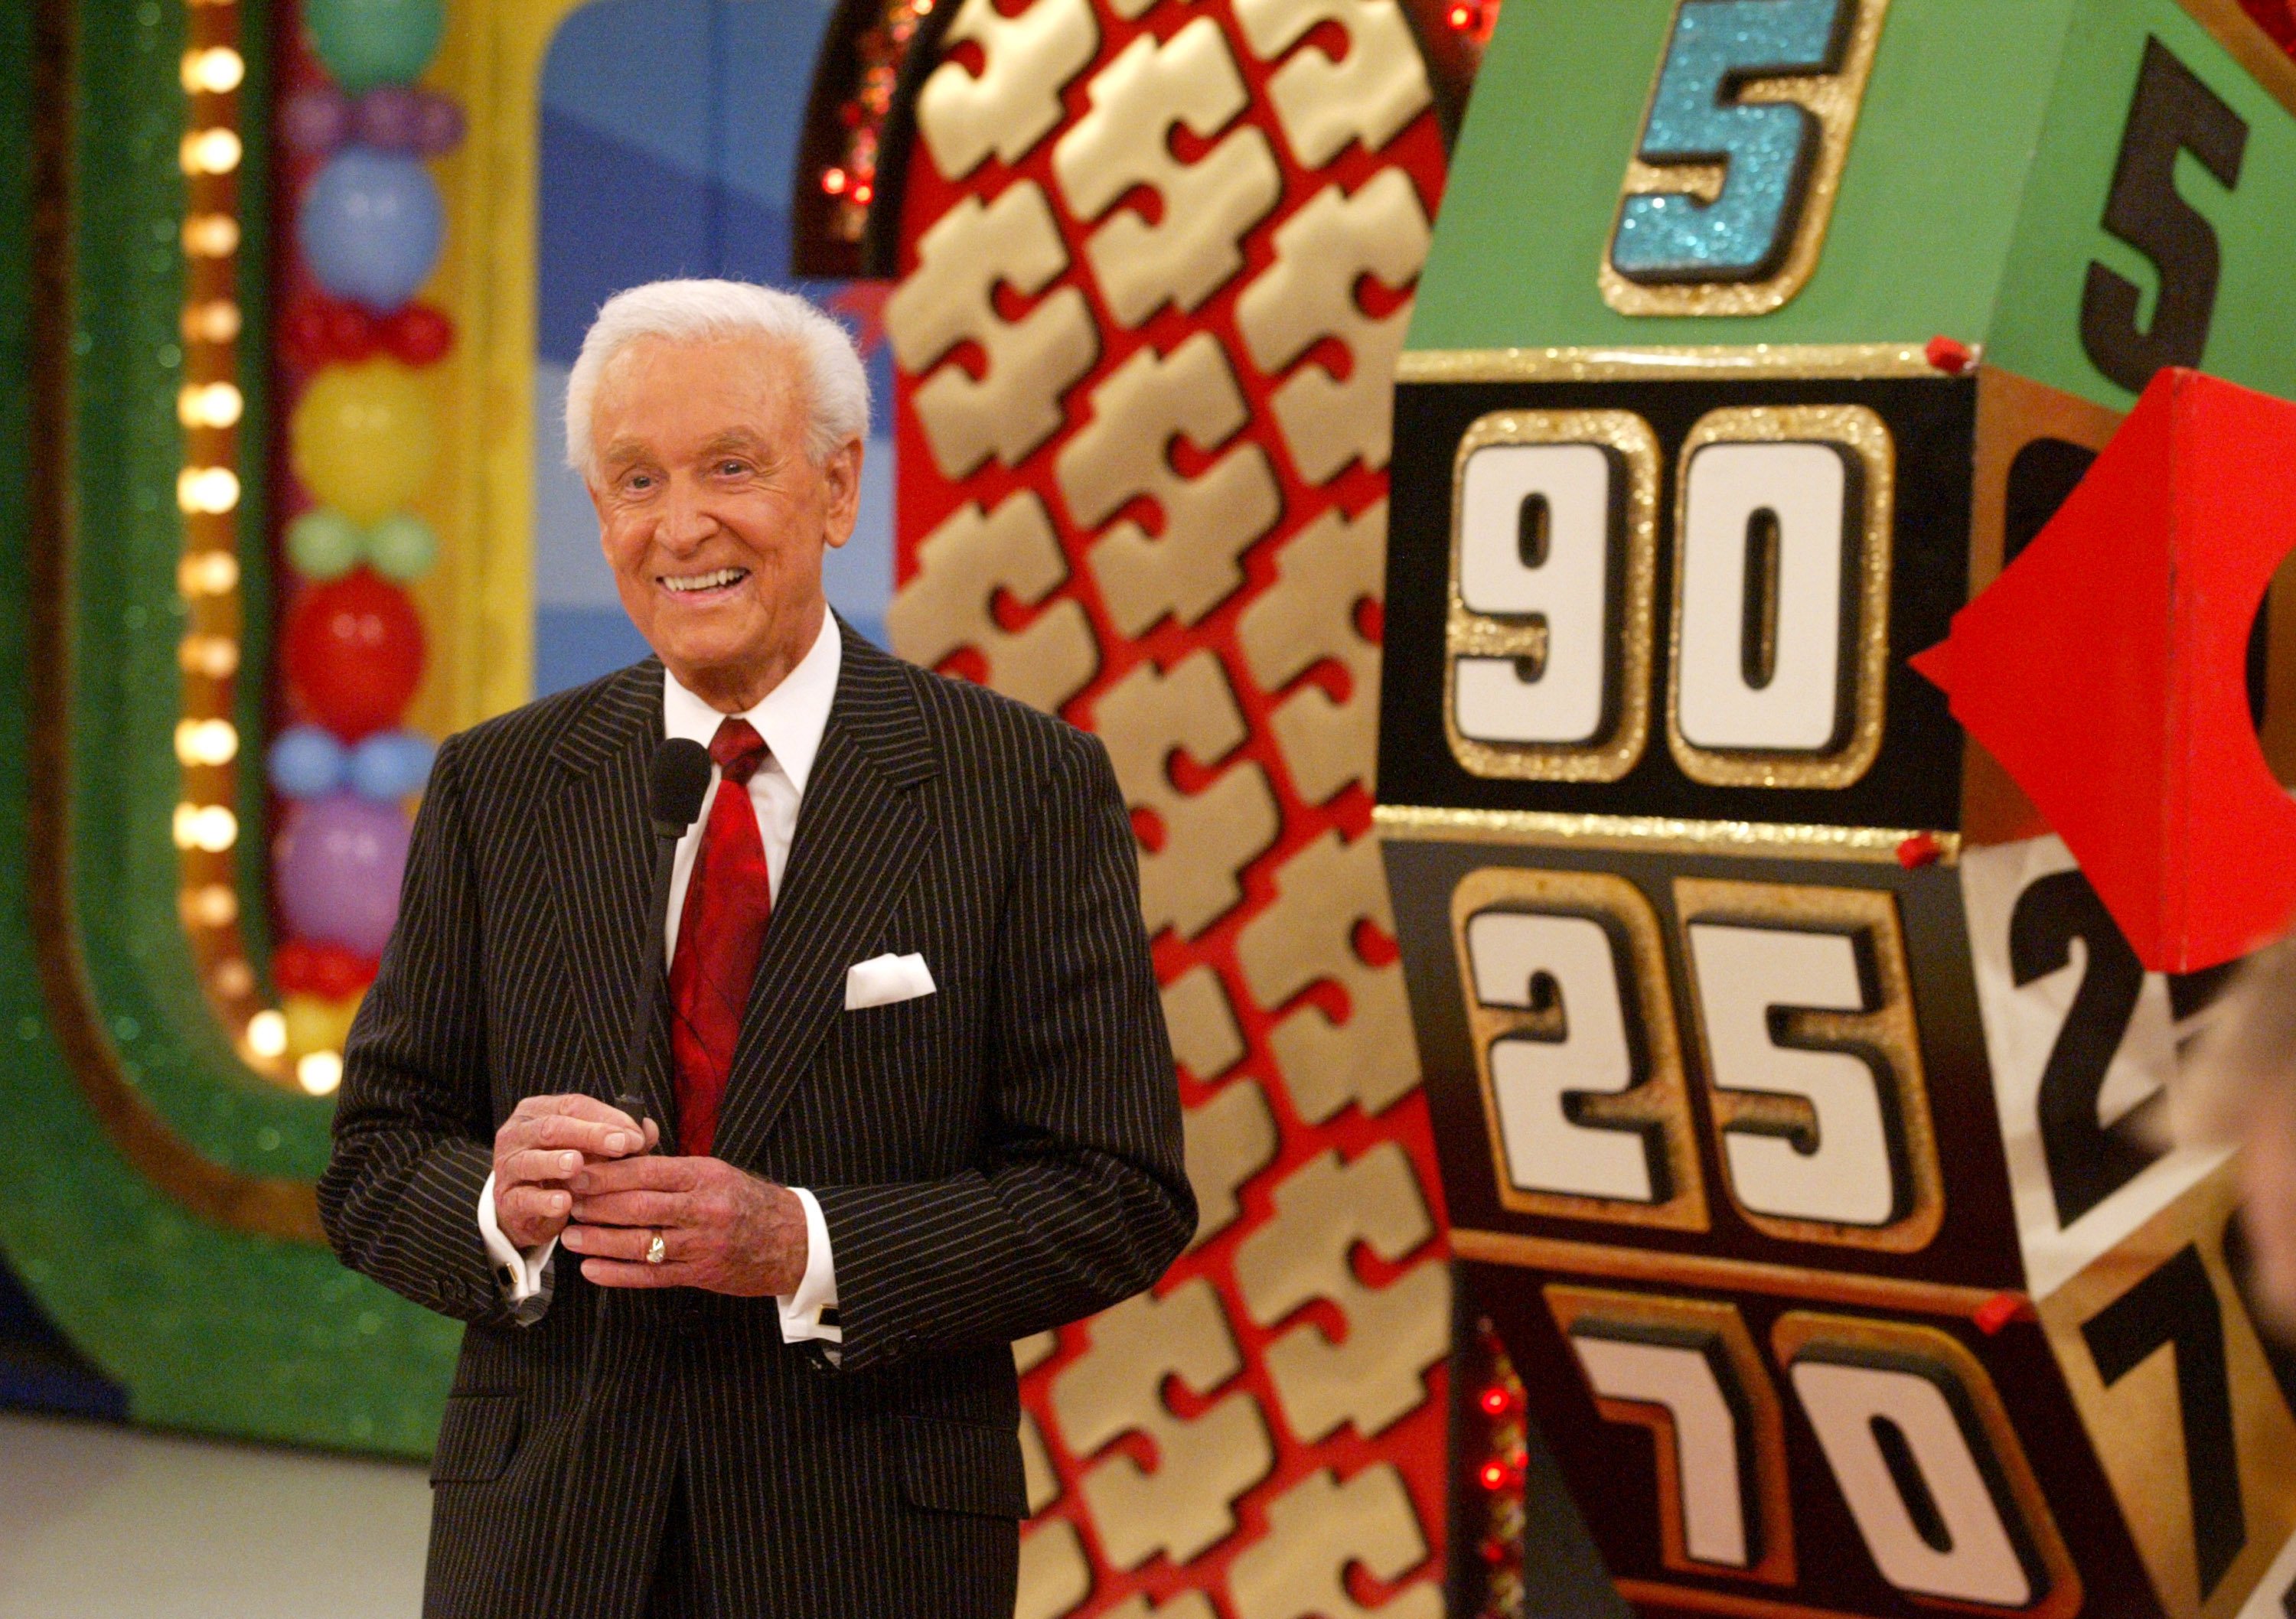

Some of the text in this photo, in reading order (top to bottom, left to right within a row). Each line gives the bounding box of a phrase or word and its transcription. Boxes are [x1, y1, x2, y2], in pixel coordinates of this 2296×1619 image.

[1609, 0, 1858, 286] 5
[2079, 32, 2251, 396] 5
[1453, 439, 1866, 756] 90
[1465, 907, 1913, 1229] 25
[2009, 868, 2242, 1233] 2
[1564, 1318, 2057, 1611] 70
